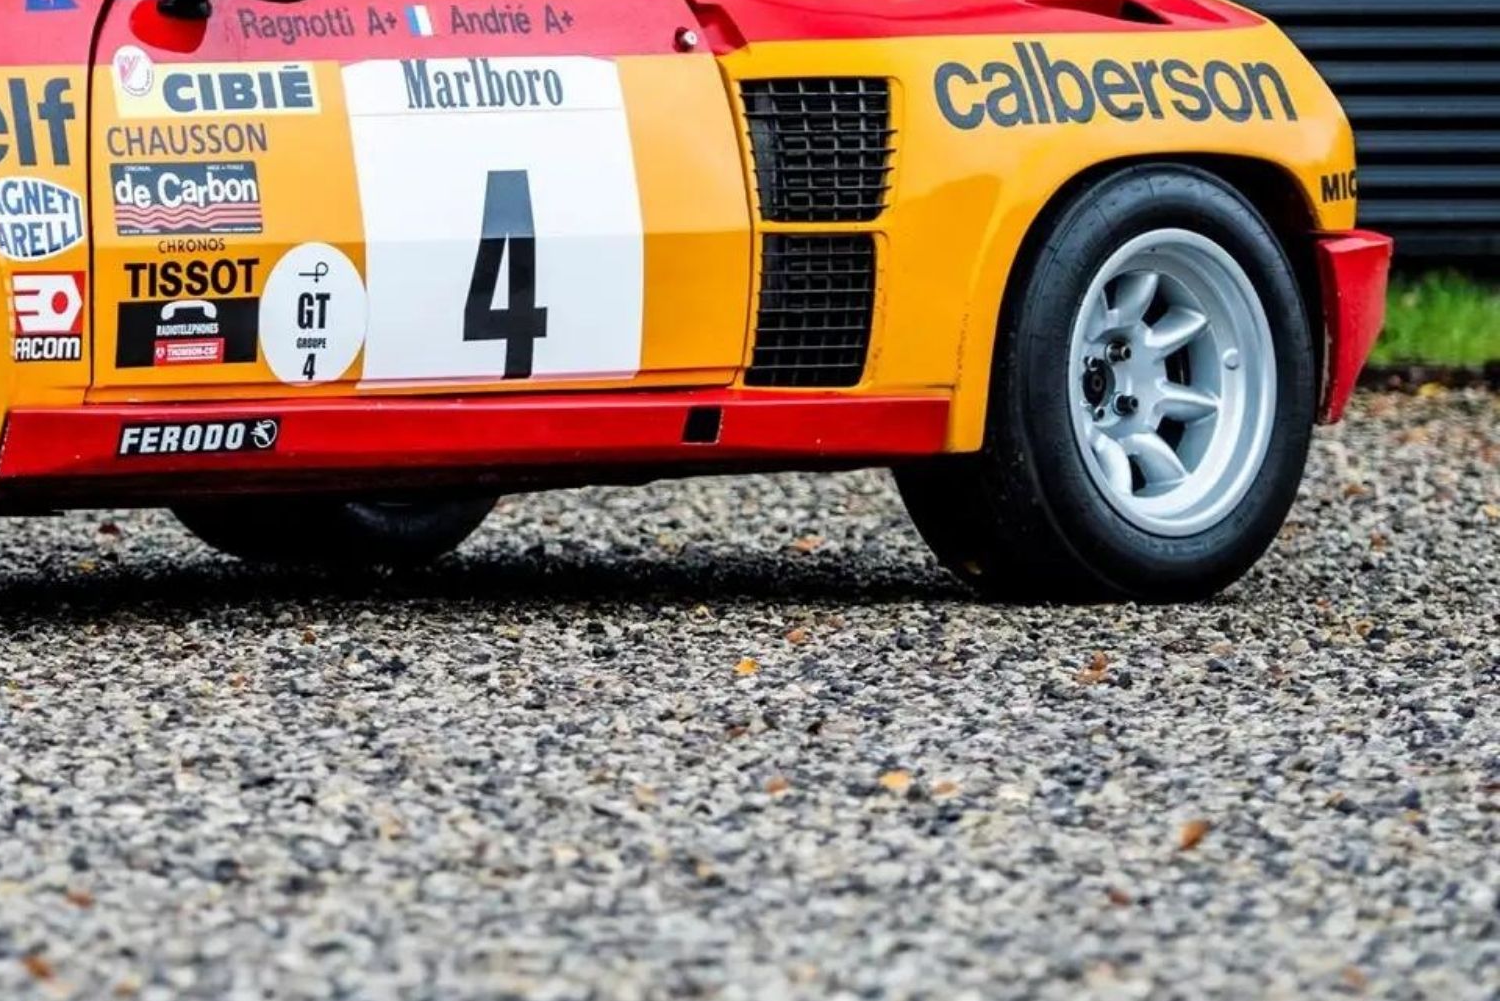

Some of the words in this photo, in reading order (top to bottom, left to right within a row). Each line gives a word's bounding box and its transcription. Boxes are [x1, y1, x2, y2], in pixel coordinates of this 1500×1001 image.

[238, 7, 355, 45] Ragnotti
[367, 8, 398, 37] A+
[451, 4, 531, 35] Andrié
[544, 5, 575, 35] A+
[400, 57, 564, 110] Marlboro
[933, 41, 1298, 130] calberson
[107, 123, 268, 156] CHAUSSON
[115, 173, 151, 208] de
[157, 171, 258, 208] Carbon
[158, 238, 225, 253] CHRONOS
[124, 258, 260, 297] TISSOT
[463, 169, 548, 380] 4
[297, 292, 330, 330] GT
[15, 337, 81, 359] FACOM
[297, 337, 326, 349] GROUPE
[303, 353, 316, 381] 4
[120, 422, 246, 454] FERODO
